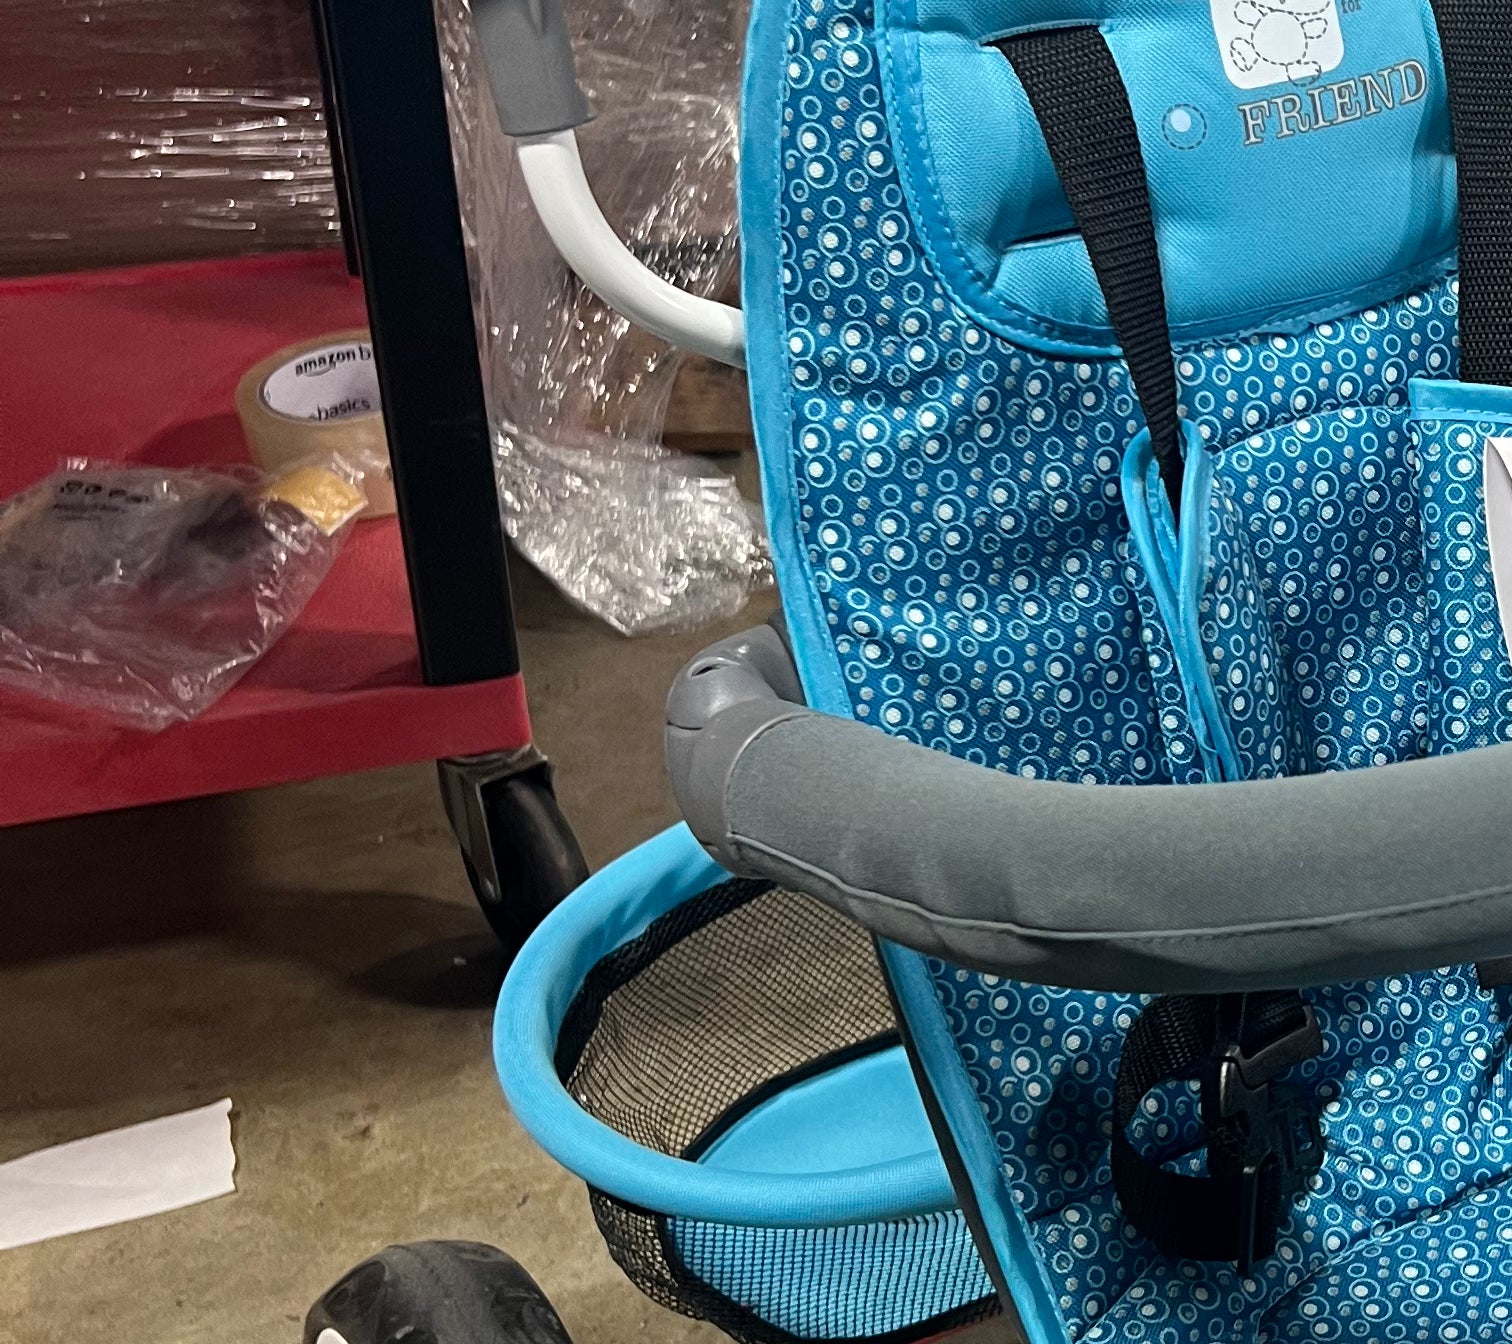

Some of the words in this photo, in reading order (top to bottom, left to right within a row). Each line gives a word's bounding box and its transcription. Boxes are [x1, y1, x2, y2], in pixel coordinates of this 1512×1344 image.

[1238, 59, 1427, 146] FRIEND
[295, 348, 356, 375] amazon
[316, 398, 371, 422] basics
